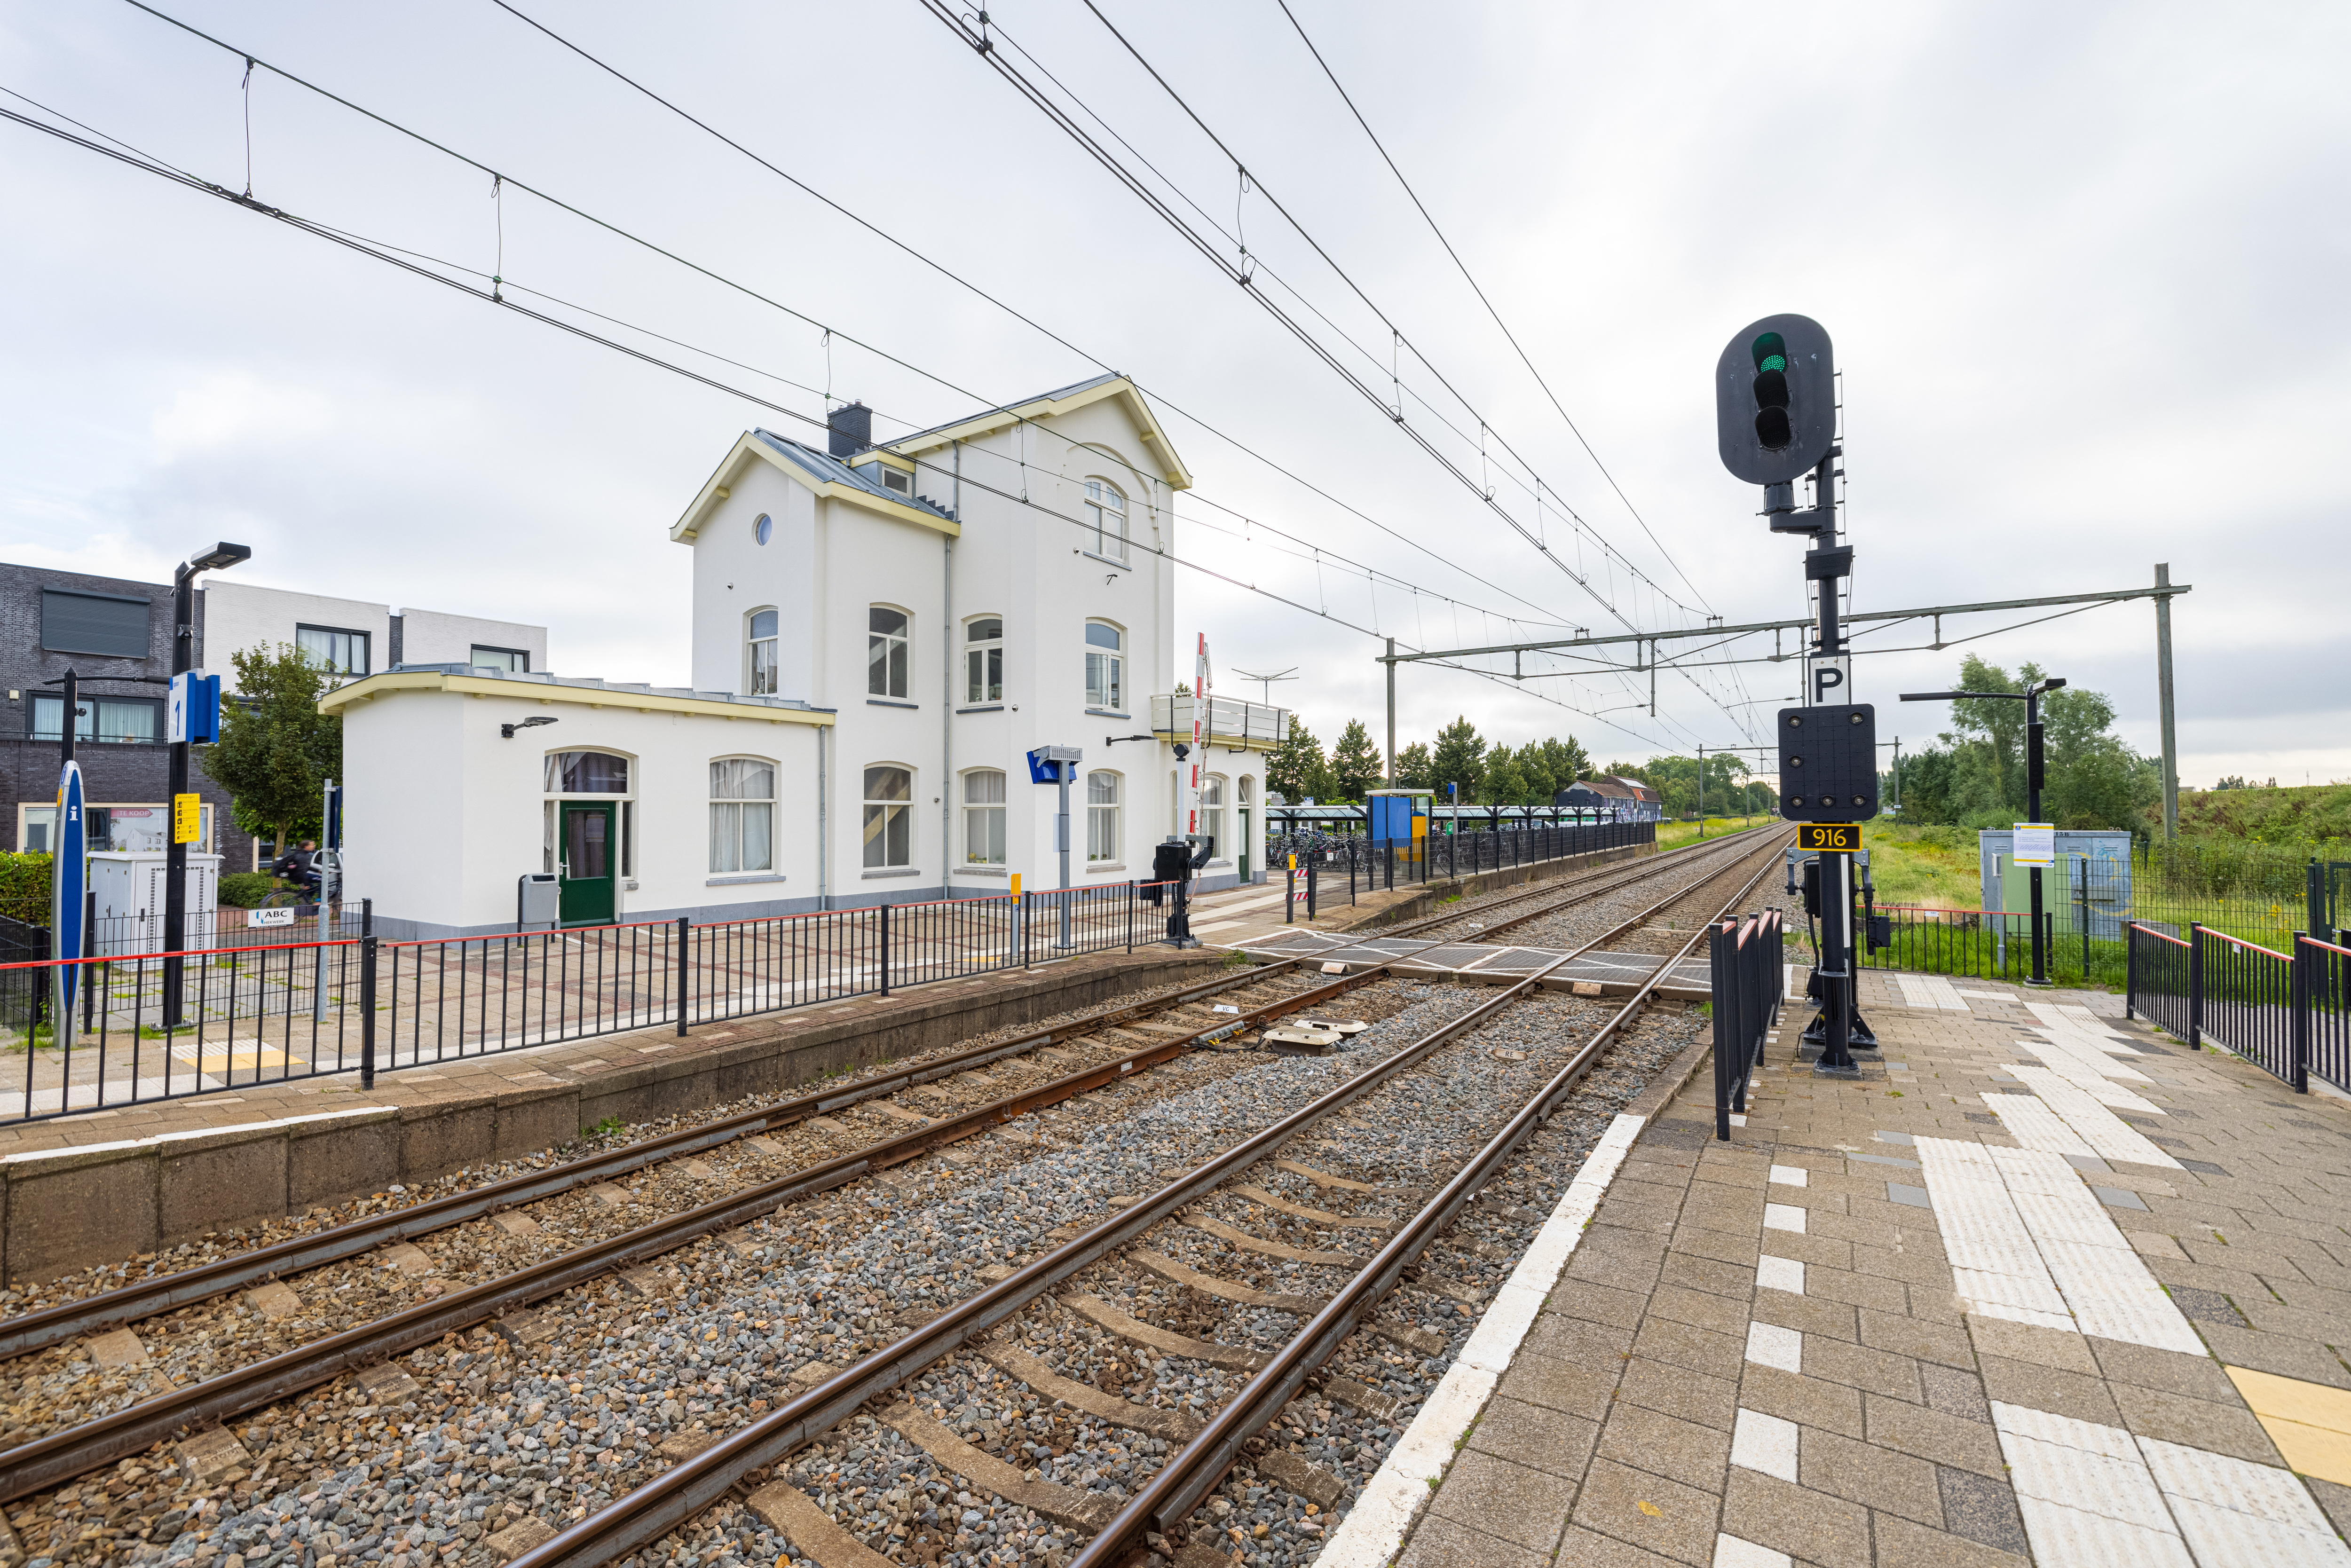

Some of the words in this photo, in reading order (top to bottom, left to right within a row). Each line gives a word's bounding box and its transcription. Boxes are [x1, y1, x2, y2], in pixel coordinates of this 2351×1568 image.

[1815, 668, 1844, 702] P
[175, 700, 180, 736] 1
[1813, 829, 1846, 846] 916
